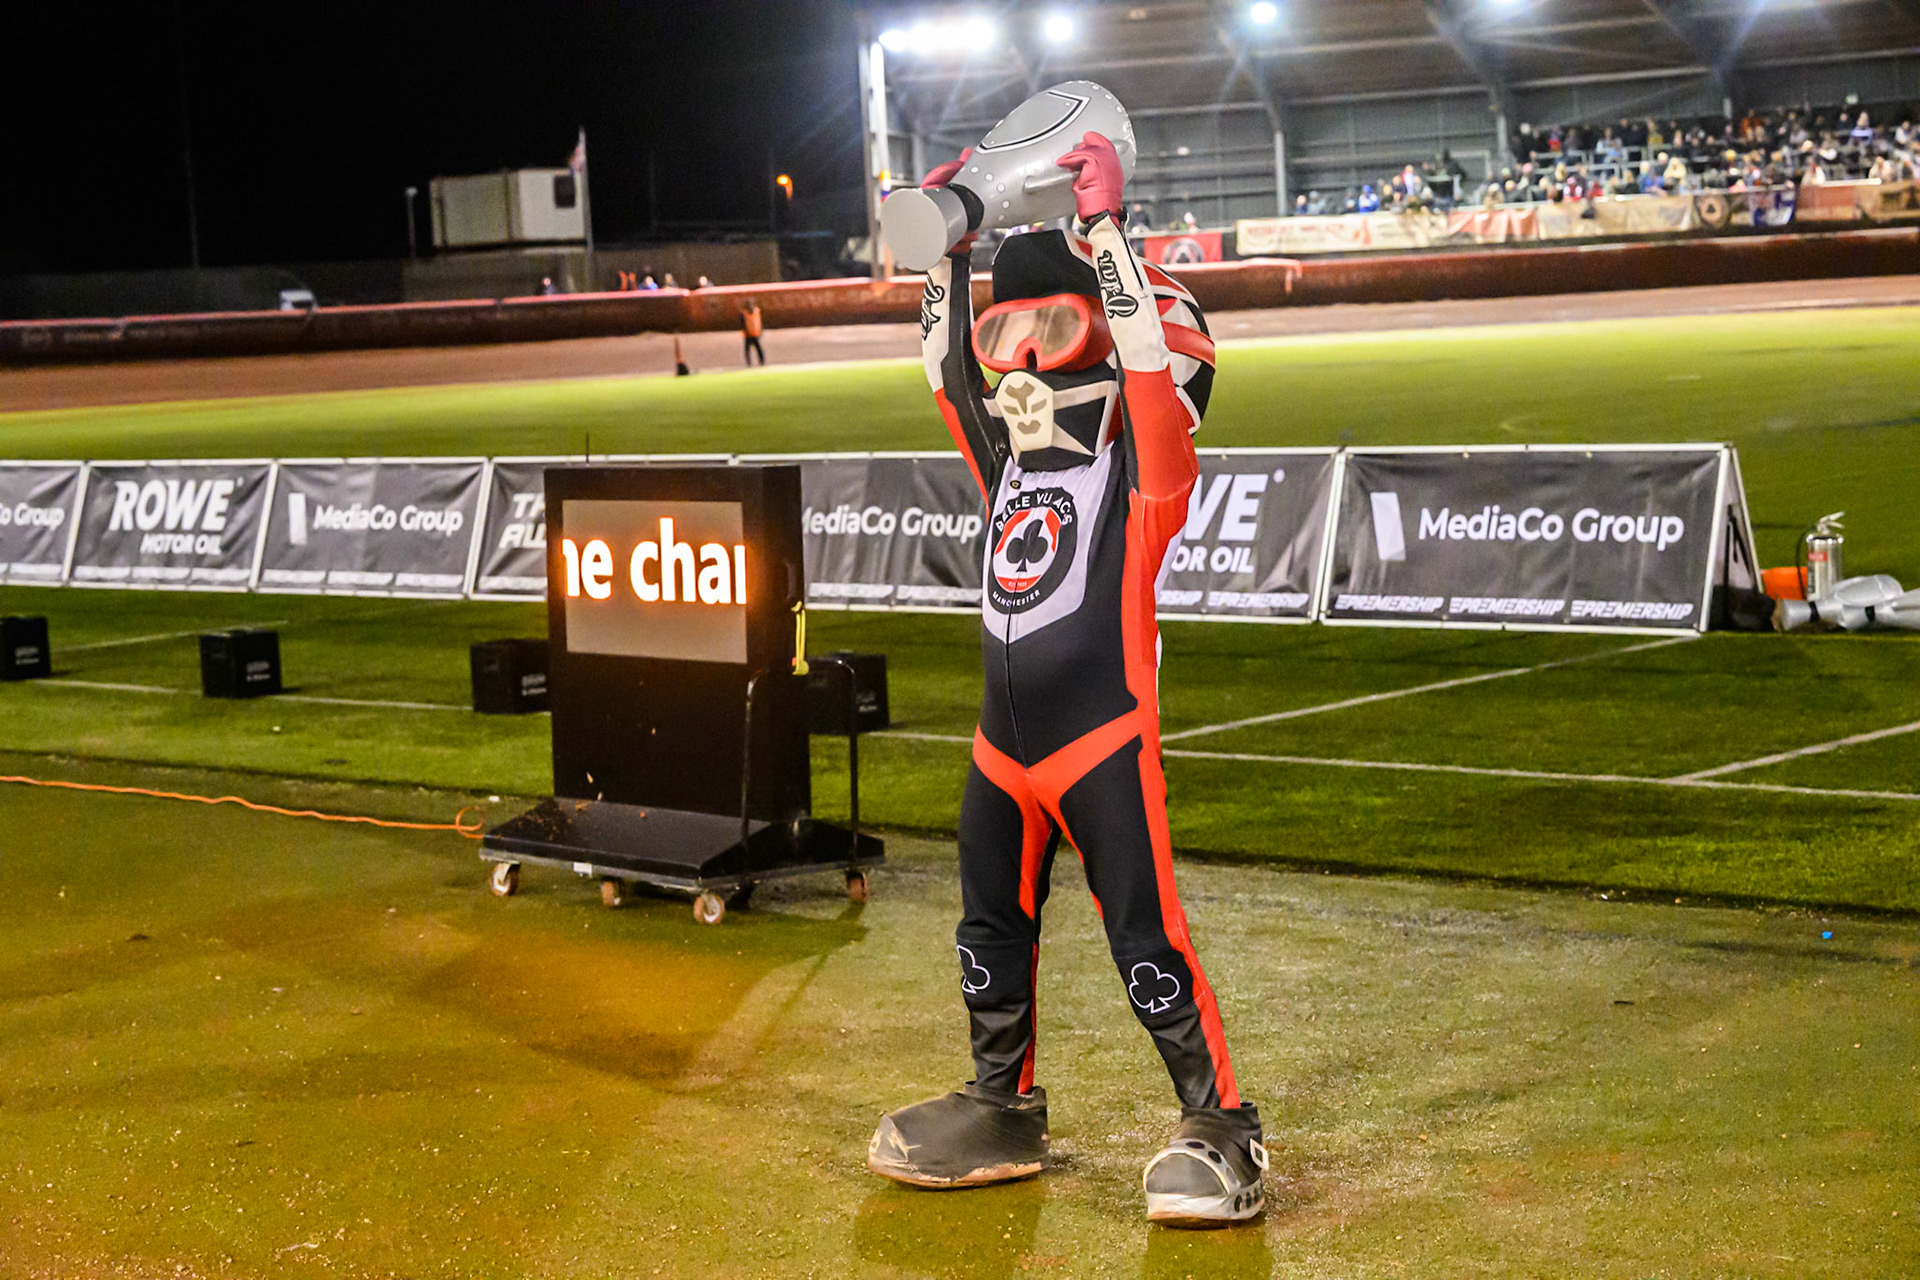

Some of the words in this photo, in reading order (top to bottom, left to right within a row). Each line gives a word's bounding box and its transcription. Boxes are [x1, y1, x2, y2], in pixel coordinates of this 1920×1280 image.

[14, 502, 65, 531] Group
[108, 479, 235, 531] ROWE
[313, 503, 397, 531] MediaCo
[400, 504, 463, 537] Group
[901, 506, 983, 545] Group
[1418, 505, 1564, 541] MediaCo
[1572, 507, 1685, 551] Group
[140, 533, 195, 554] MOTOR
[195, 533, 222, 555] OIL
[1210, 546, 1255, 573] OIL
